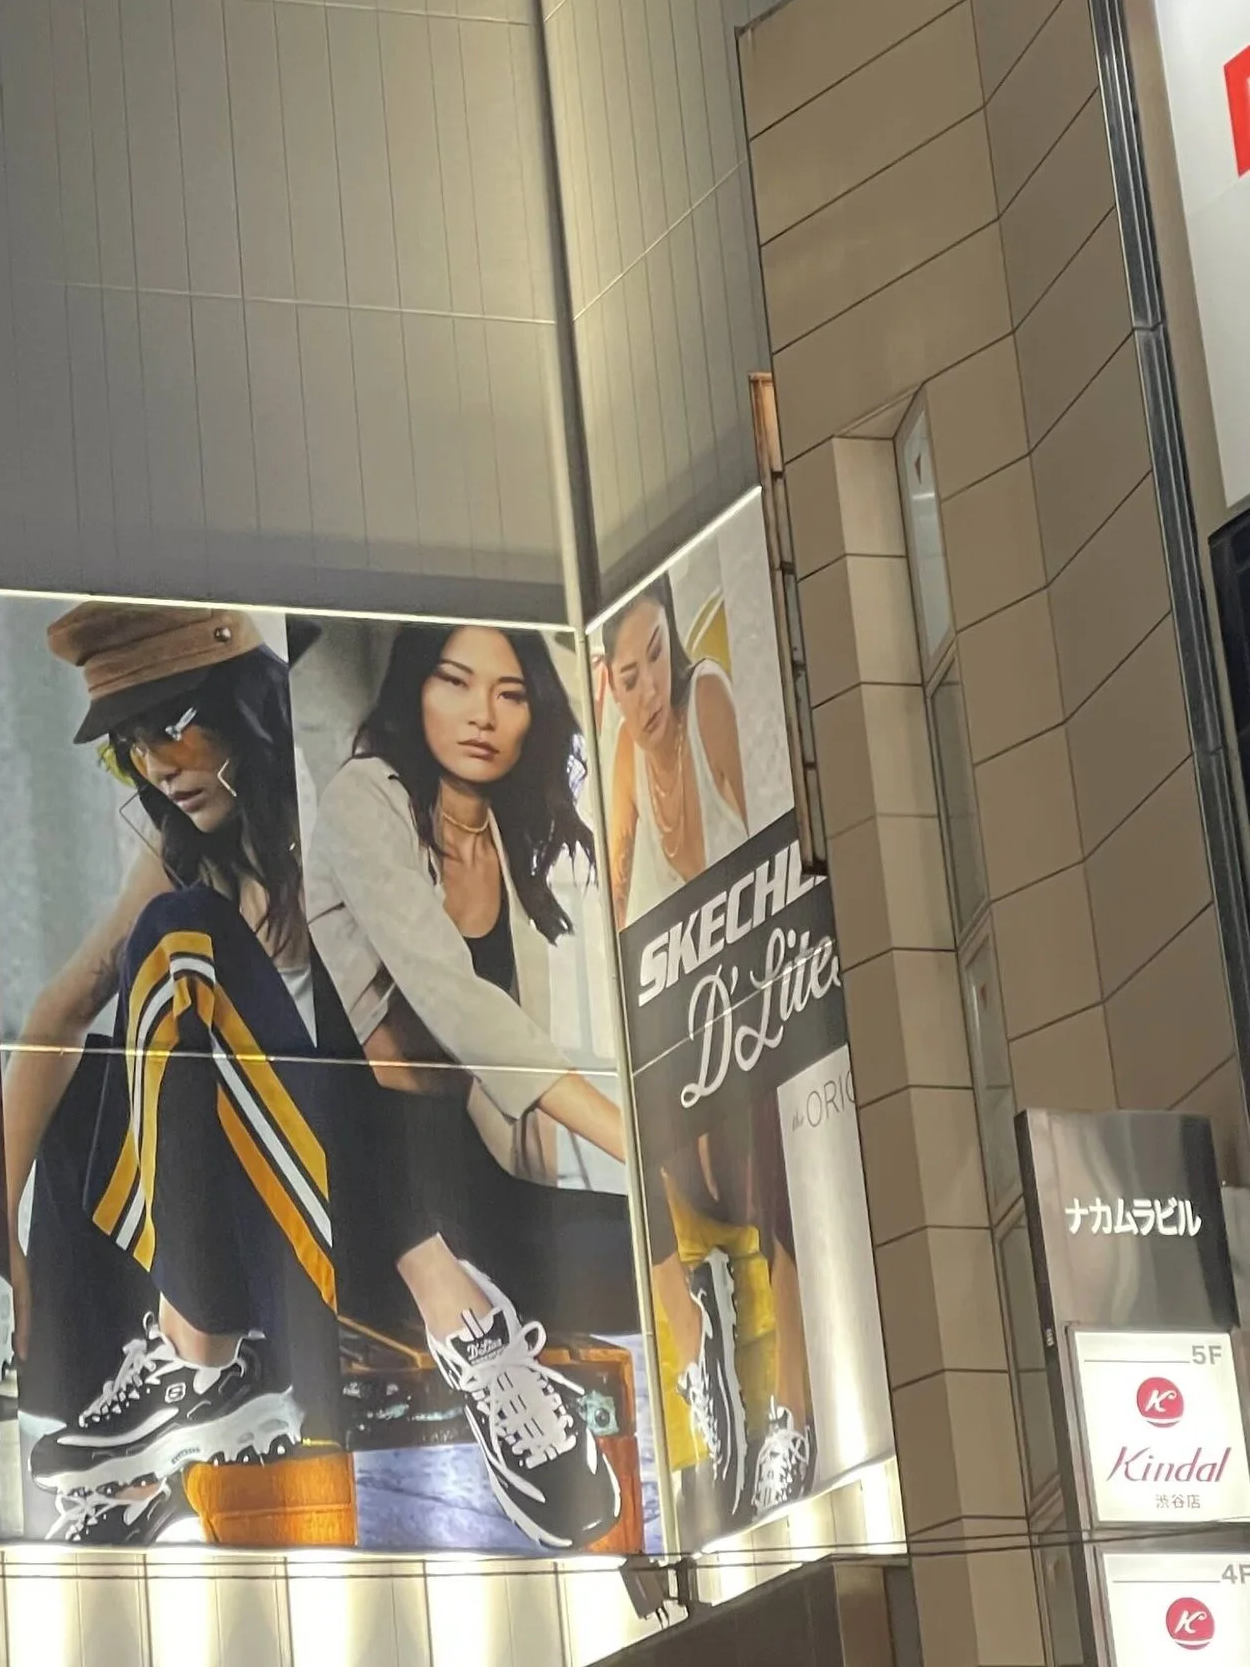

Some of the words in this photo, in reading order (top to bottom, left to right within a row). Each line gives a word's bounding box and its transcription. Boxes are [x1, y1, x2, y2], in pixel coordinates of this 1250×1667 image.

[1065, 1198, 1202, 1236] ナカムラビル
[1192, 1345, 1222, 1365] 5F
[1108, 1445, 1232, 1483] Kindal
[1155, 1494, 1201, 1508] 渋谷店
[1222, 1564, 1250, 1584] 4F
